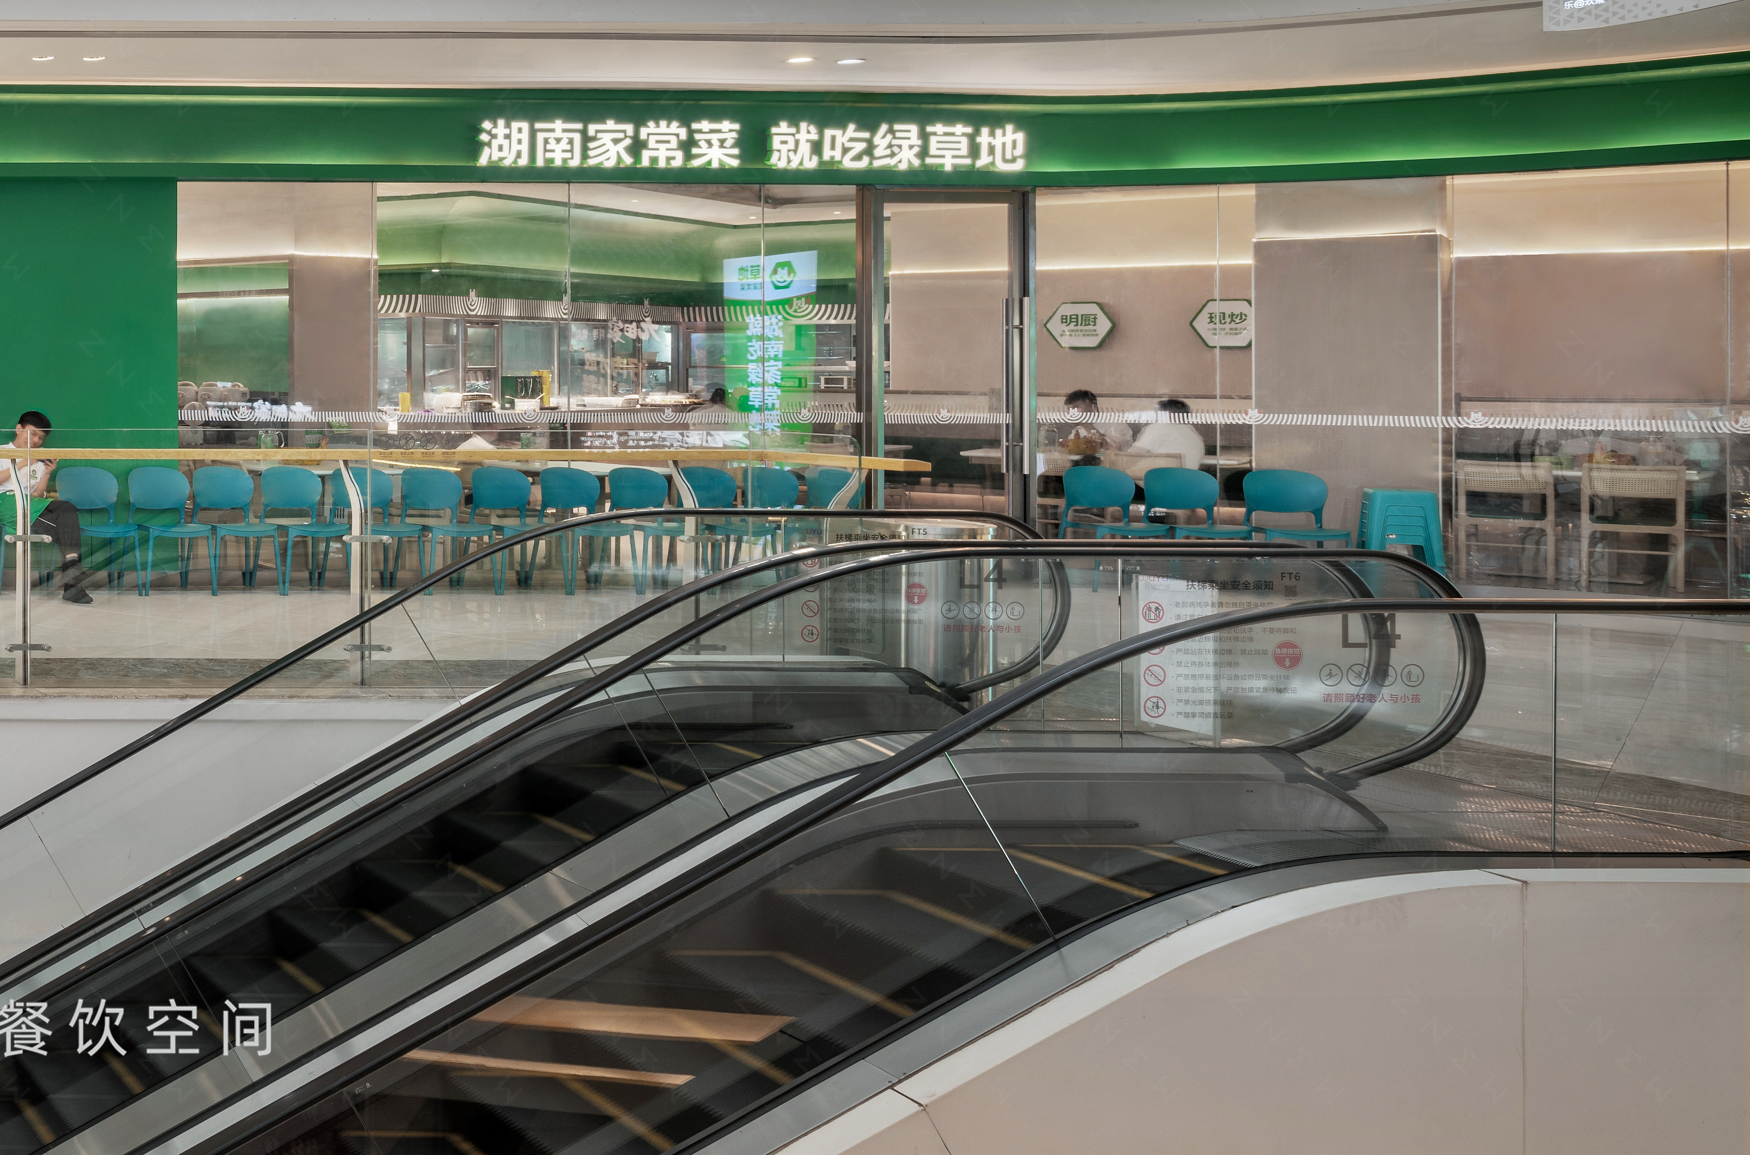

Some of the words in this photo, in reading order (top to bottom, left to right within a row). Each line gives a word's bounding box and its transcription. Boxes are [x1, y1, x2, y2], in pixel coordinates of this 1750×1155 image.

[480, 120, 741, 167] 湖南家常菜
[771, 122, 1027, 171] 就吃绿草地
[1061, 314, 1098, 327] 明厨
[1207, 311, 1248, 325] 现炒
[911, 528, 928, 536] FT5
[1280, 572, 1301, 581] FT6
[1186, 580, 1274, 591] 扶梯乘坐安全须知
[1342, 613, 1402, 649] L4
[1322, 693, 1421, 704] 请照顾好老人与小孩
